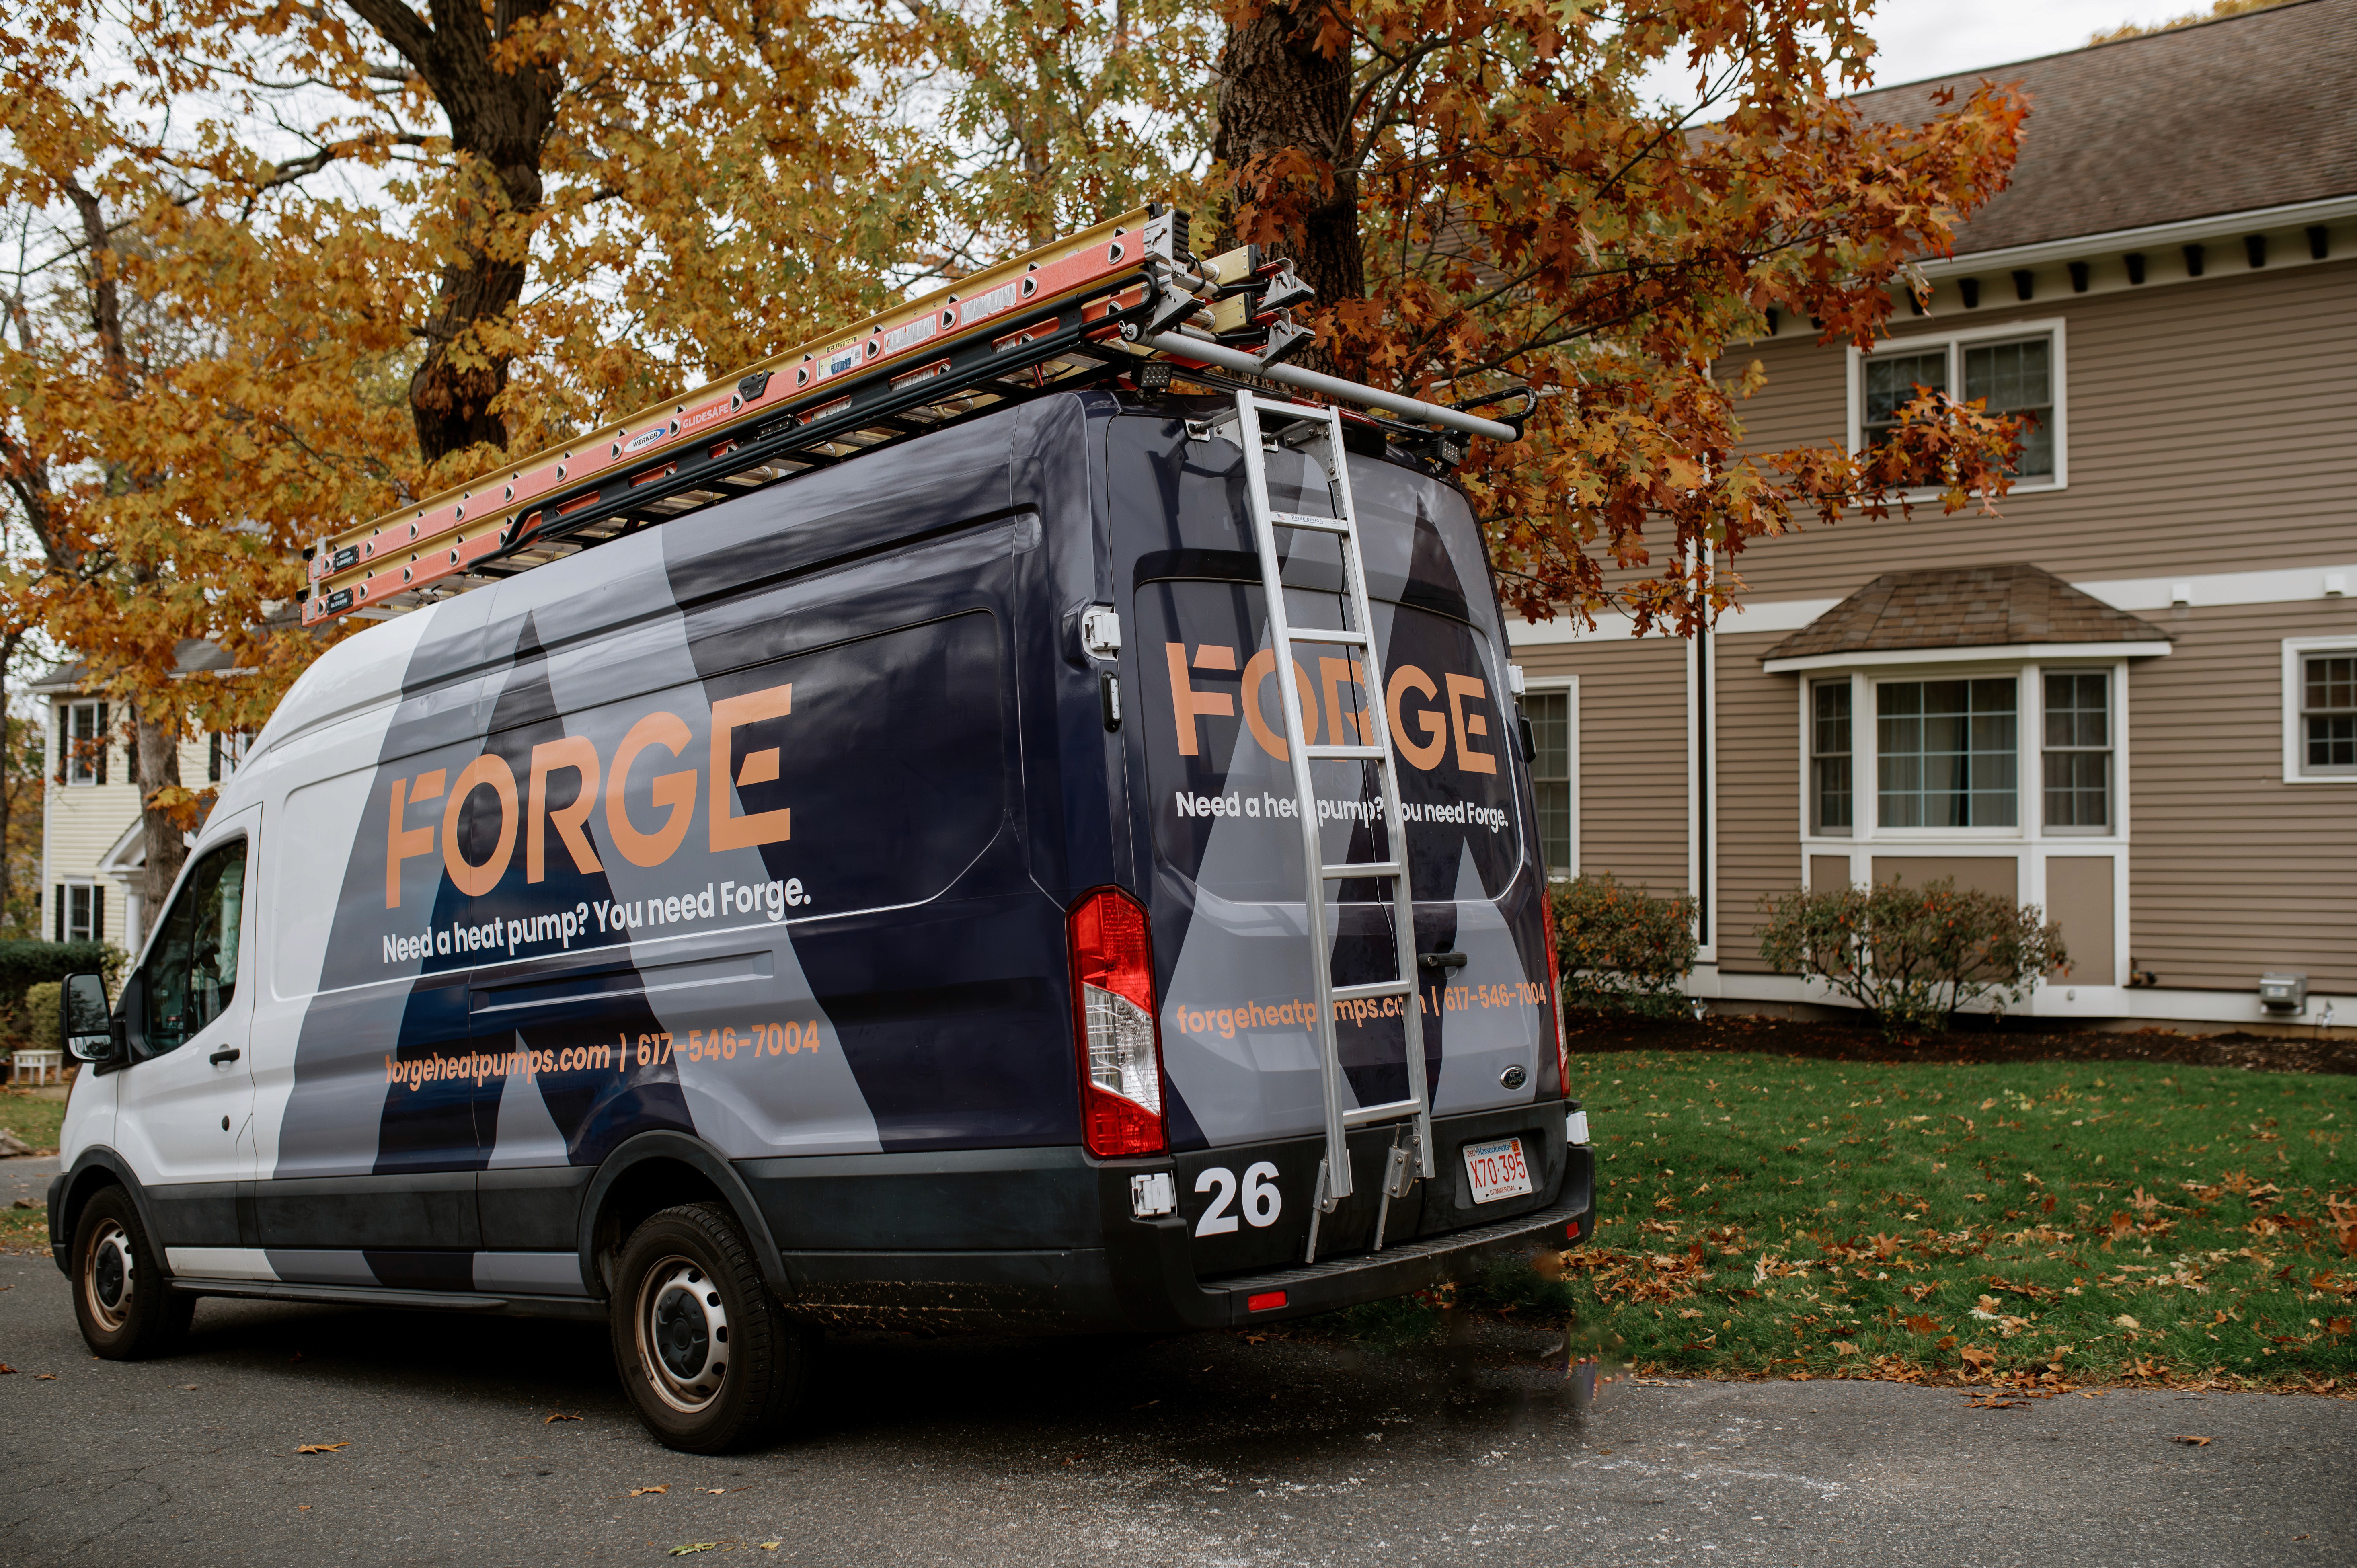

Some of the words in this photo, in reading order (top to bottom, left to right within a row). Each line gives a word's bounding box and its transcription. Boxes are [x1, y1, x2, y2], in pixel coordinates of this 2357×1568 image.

[829, 337, 854, 352] CAUTION
[682, 403, 729, 429] GLIDESAFE
[633, 432, 657, 447] WERNER
[1165, 642, 1497, 775] FORGE
[386, 683, 792, 909] FORGE
[1176, 791, 1241, 817] Need
[1245, 797, 1260, 817] a
[1316, 796, 1384, 828] pump?
[1401, 802, 1422, 822] ou
[1424, 801, 1465, 823] need
[1467, 802, 1508, 833] Forge.
[383, 926, 433, 963] Need
[437, 930, 451, 955] a
[454, 917, 504, 953] heat
[507, 902, 589, 956] pump?
[593, 899, 643, 932] You
[648, 882, 715, 926] need
[721, 878, 811, 921] Forge.
[1444, 982, 1546, 1011] 617-546-7004
[385, 1045, 611, 1091] forgeheatpumps.com
[637, 1020, 820, 1066] 617-546-7004
[1509, 1071, 1523, 1084] Ford
[1476, 1144, 1509, 1156] Massachusetts
[1195, 1161, 1281, 1238] 26
[1490, 1185, 1516, 1196] COMMERCIAL
